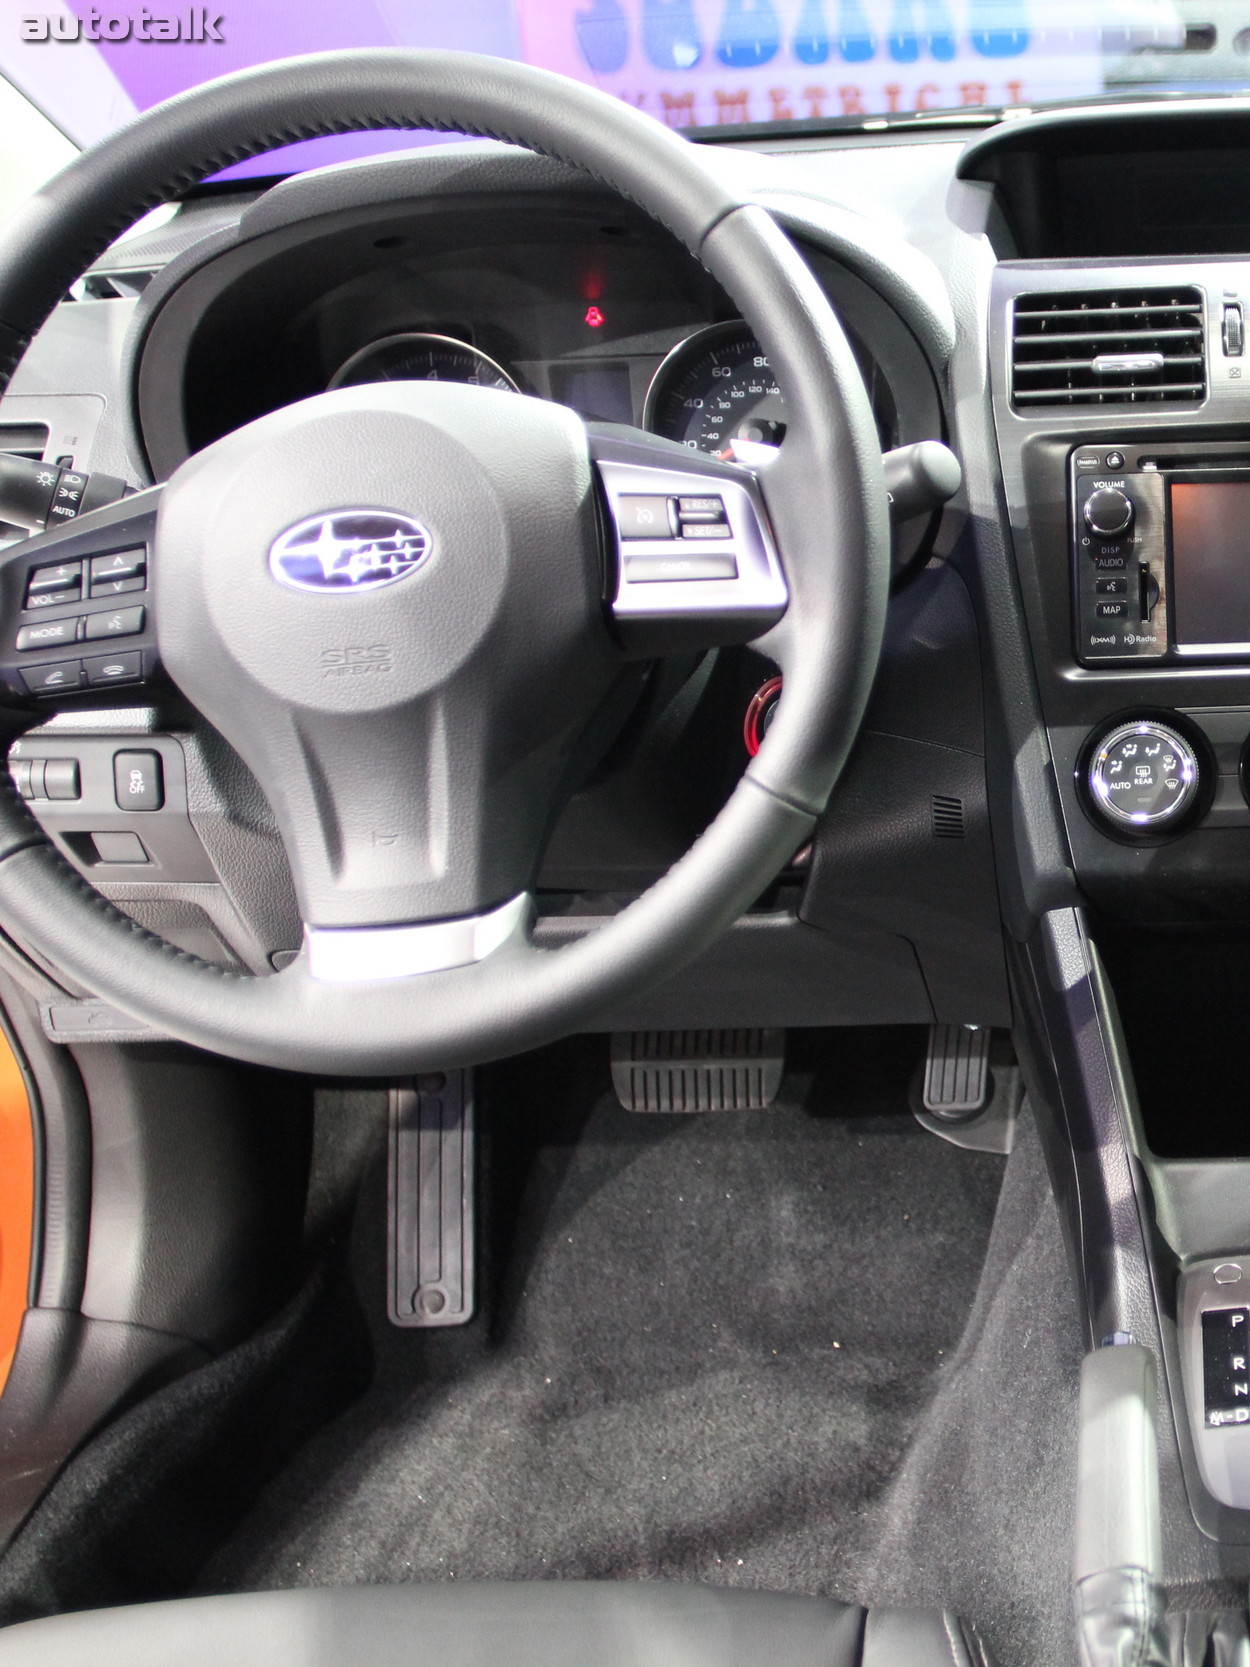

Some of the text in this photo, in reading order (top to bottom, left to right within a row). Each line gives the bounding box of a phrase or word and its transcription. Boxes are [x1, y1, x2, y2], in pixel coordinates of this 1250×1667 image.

[712, 367, 731, 377] 60
[683, 398, 704, 408] 40
[1093, 481, 1126, 489] VOLUME
[52, 504, 76, 518] AUTO
[1101, 546, 1120, 554] DISP
[1099, 558, 1124, 567] AUDIO
[1103, 605, 1121, 614] MAP
[29, 626, 65, 639] MODE
[320, 643, 393, 664] SRS
[321, 663, 394, 679] AIRBAG
[1110, 782, 1132, 790] AUTO
[1134, 777, 1154, 785] REAR
[129, 786, 145, 794] OFF
[1231, 1315, 1245, 1327] P
[1233, 1357, 1246, 1370] R
[1234, 1383, 1248, 1396] N
